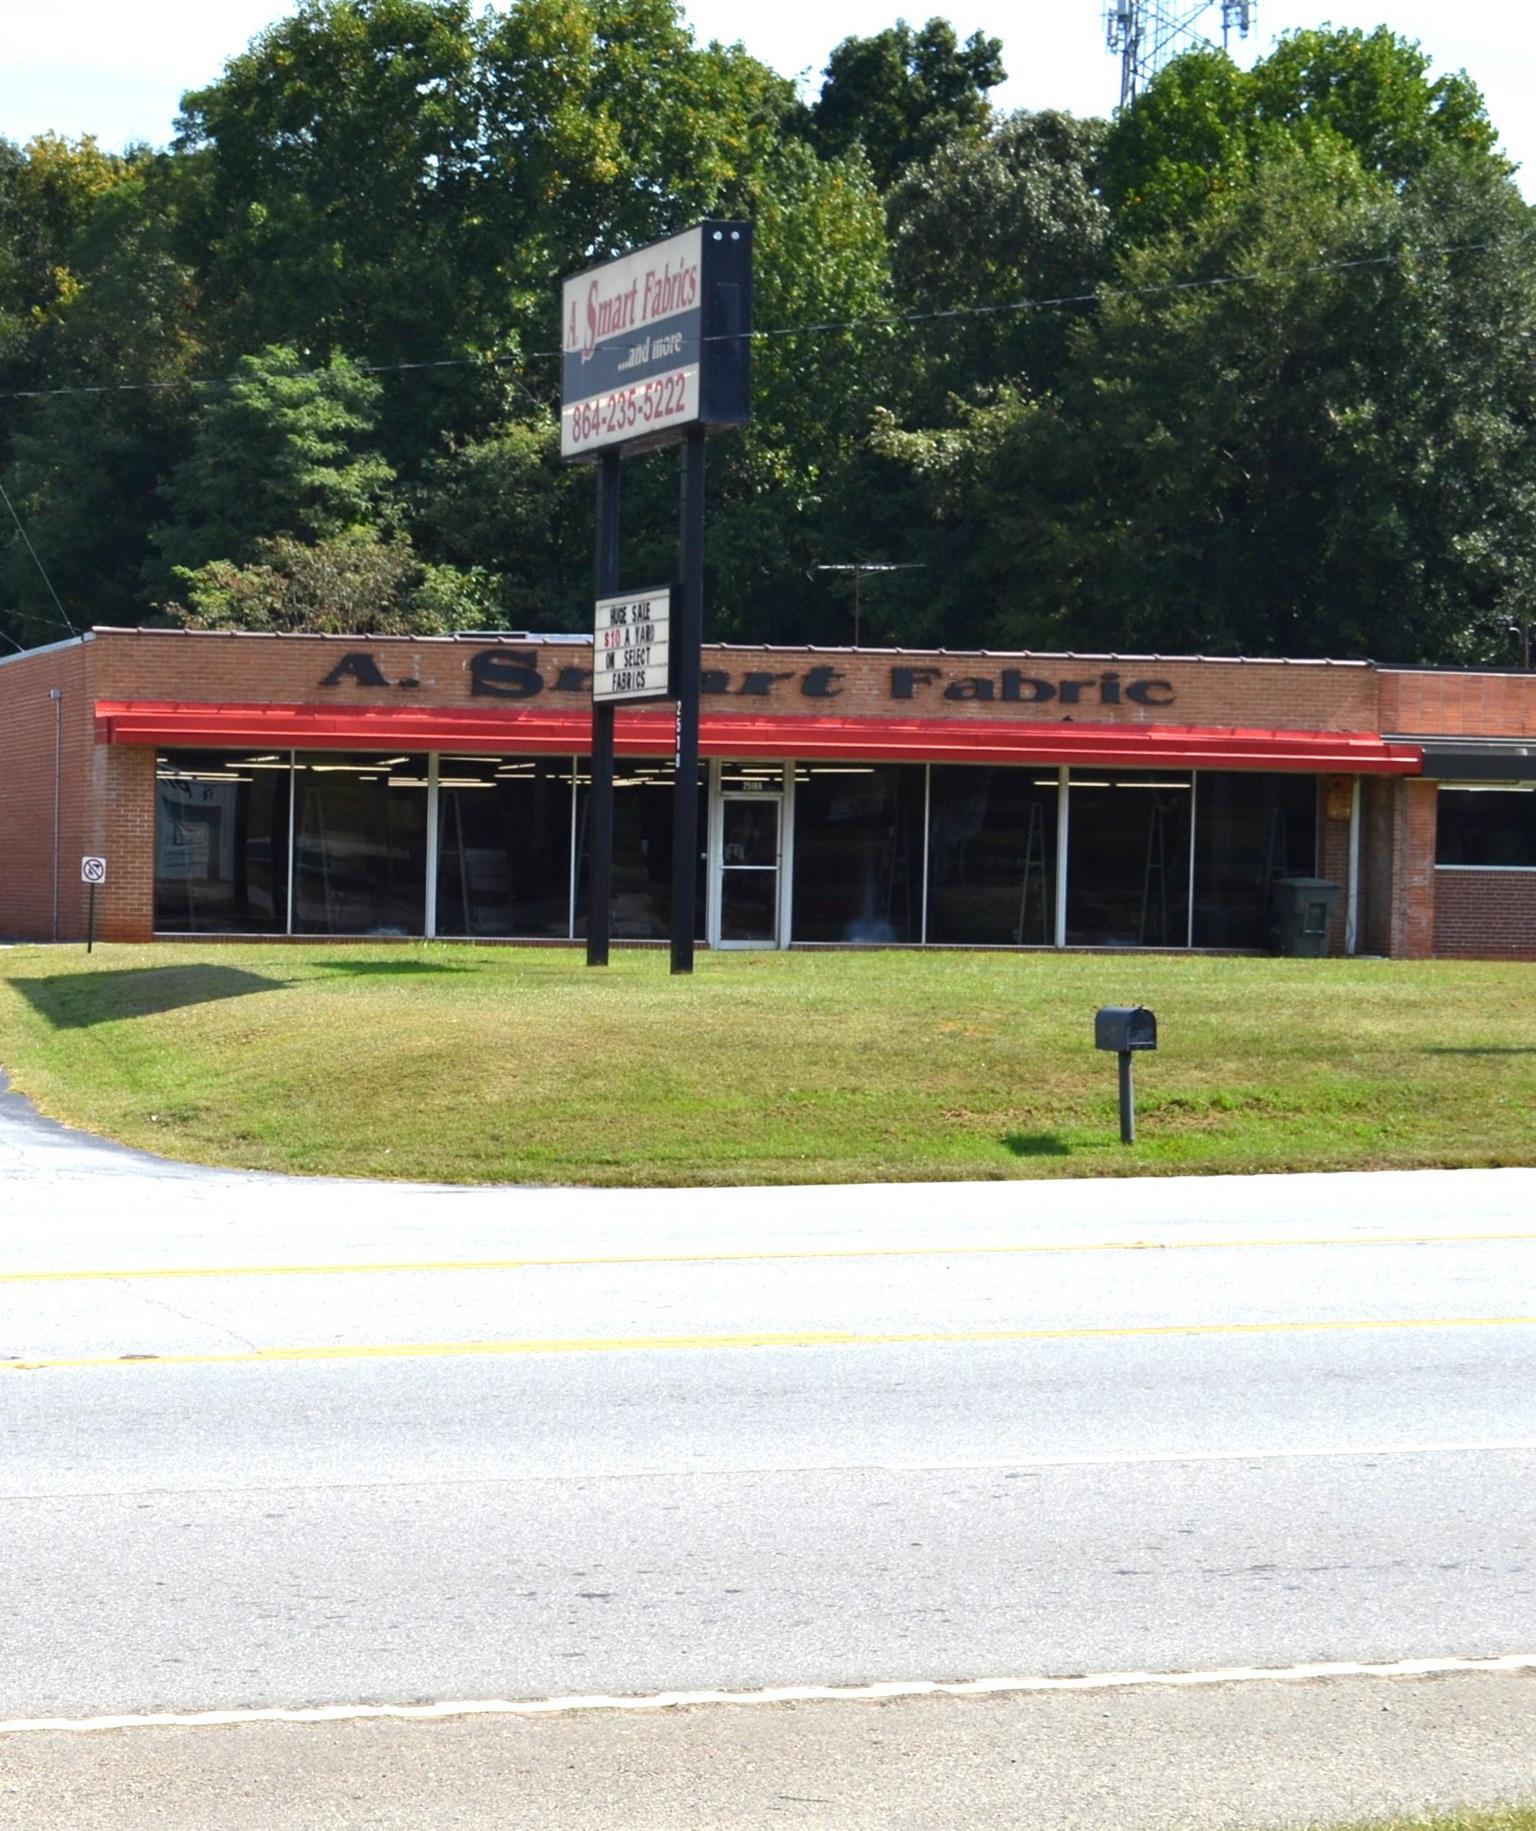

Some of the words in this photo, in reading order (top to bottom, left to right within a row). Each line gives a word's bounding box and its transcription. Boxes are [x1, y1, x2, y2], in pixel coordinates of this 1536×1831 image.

[582, 278, 638, 362] Smart
[641, 257, 697, 321] Fabrics
[652, 331, 683, 359] more
[572, 373, 686, 443] 864-235-5222
[610, 605, 628, 626] HUGE
[632, 602, 651, 622] SALE
[604, 629, 621, 648] $10
[624, 628, 630, 646] A
[635, 624, 655, 643] YARD
[606, 652, 615, 670] ON
[624, 647, 651, 667] SELECT
[319, 652, 421, 688] A.
[890, 666, 1177, 706] Fabric
[612, 671, 646, 692] FABRICS
